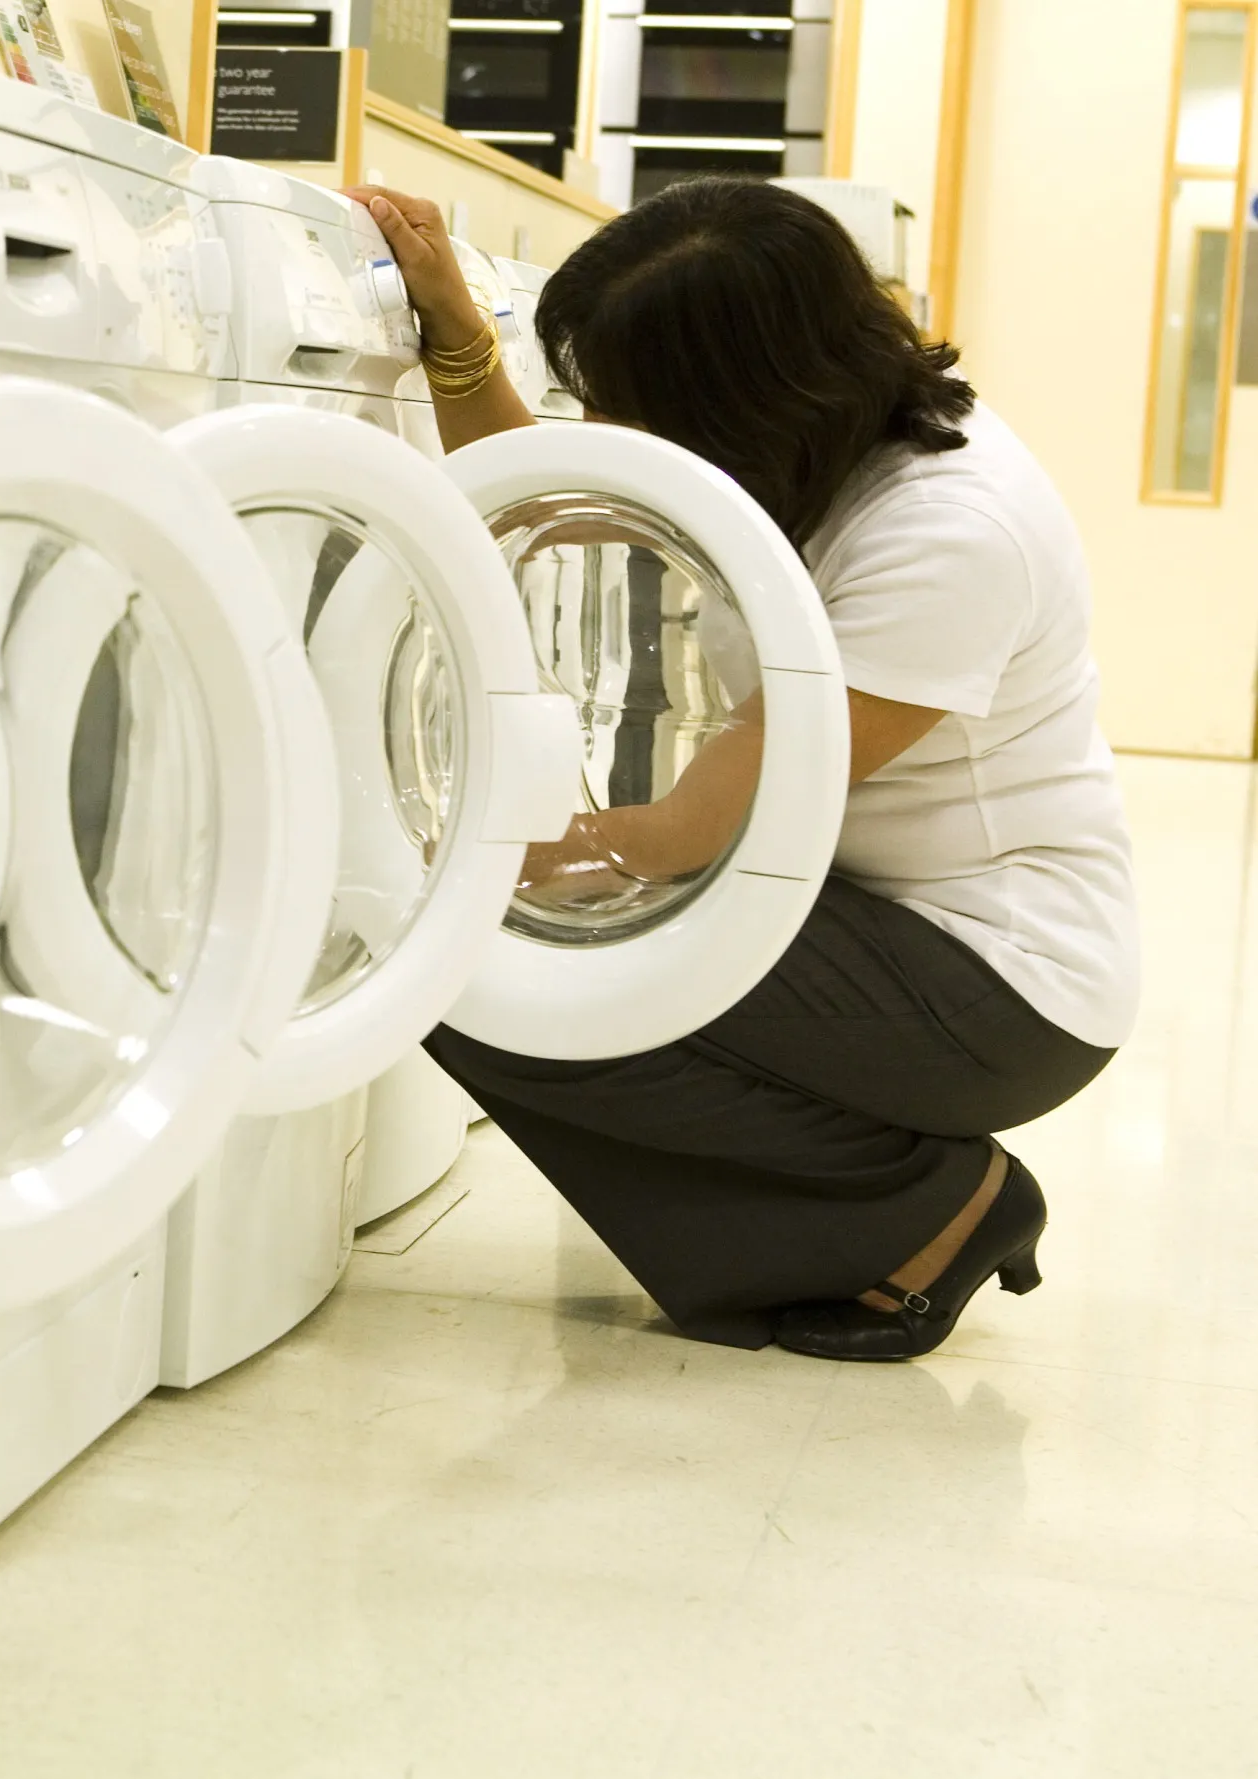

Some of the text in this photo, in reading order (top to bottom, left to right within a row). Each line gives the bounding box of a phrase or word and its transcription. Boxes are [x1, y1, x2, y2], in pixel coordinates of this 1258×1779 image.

[219, 67, 243, 78] two
[245, 68, 273, 81] year
[217, 84, 276, 98] guarantee
